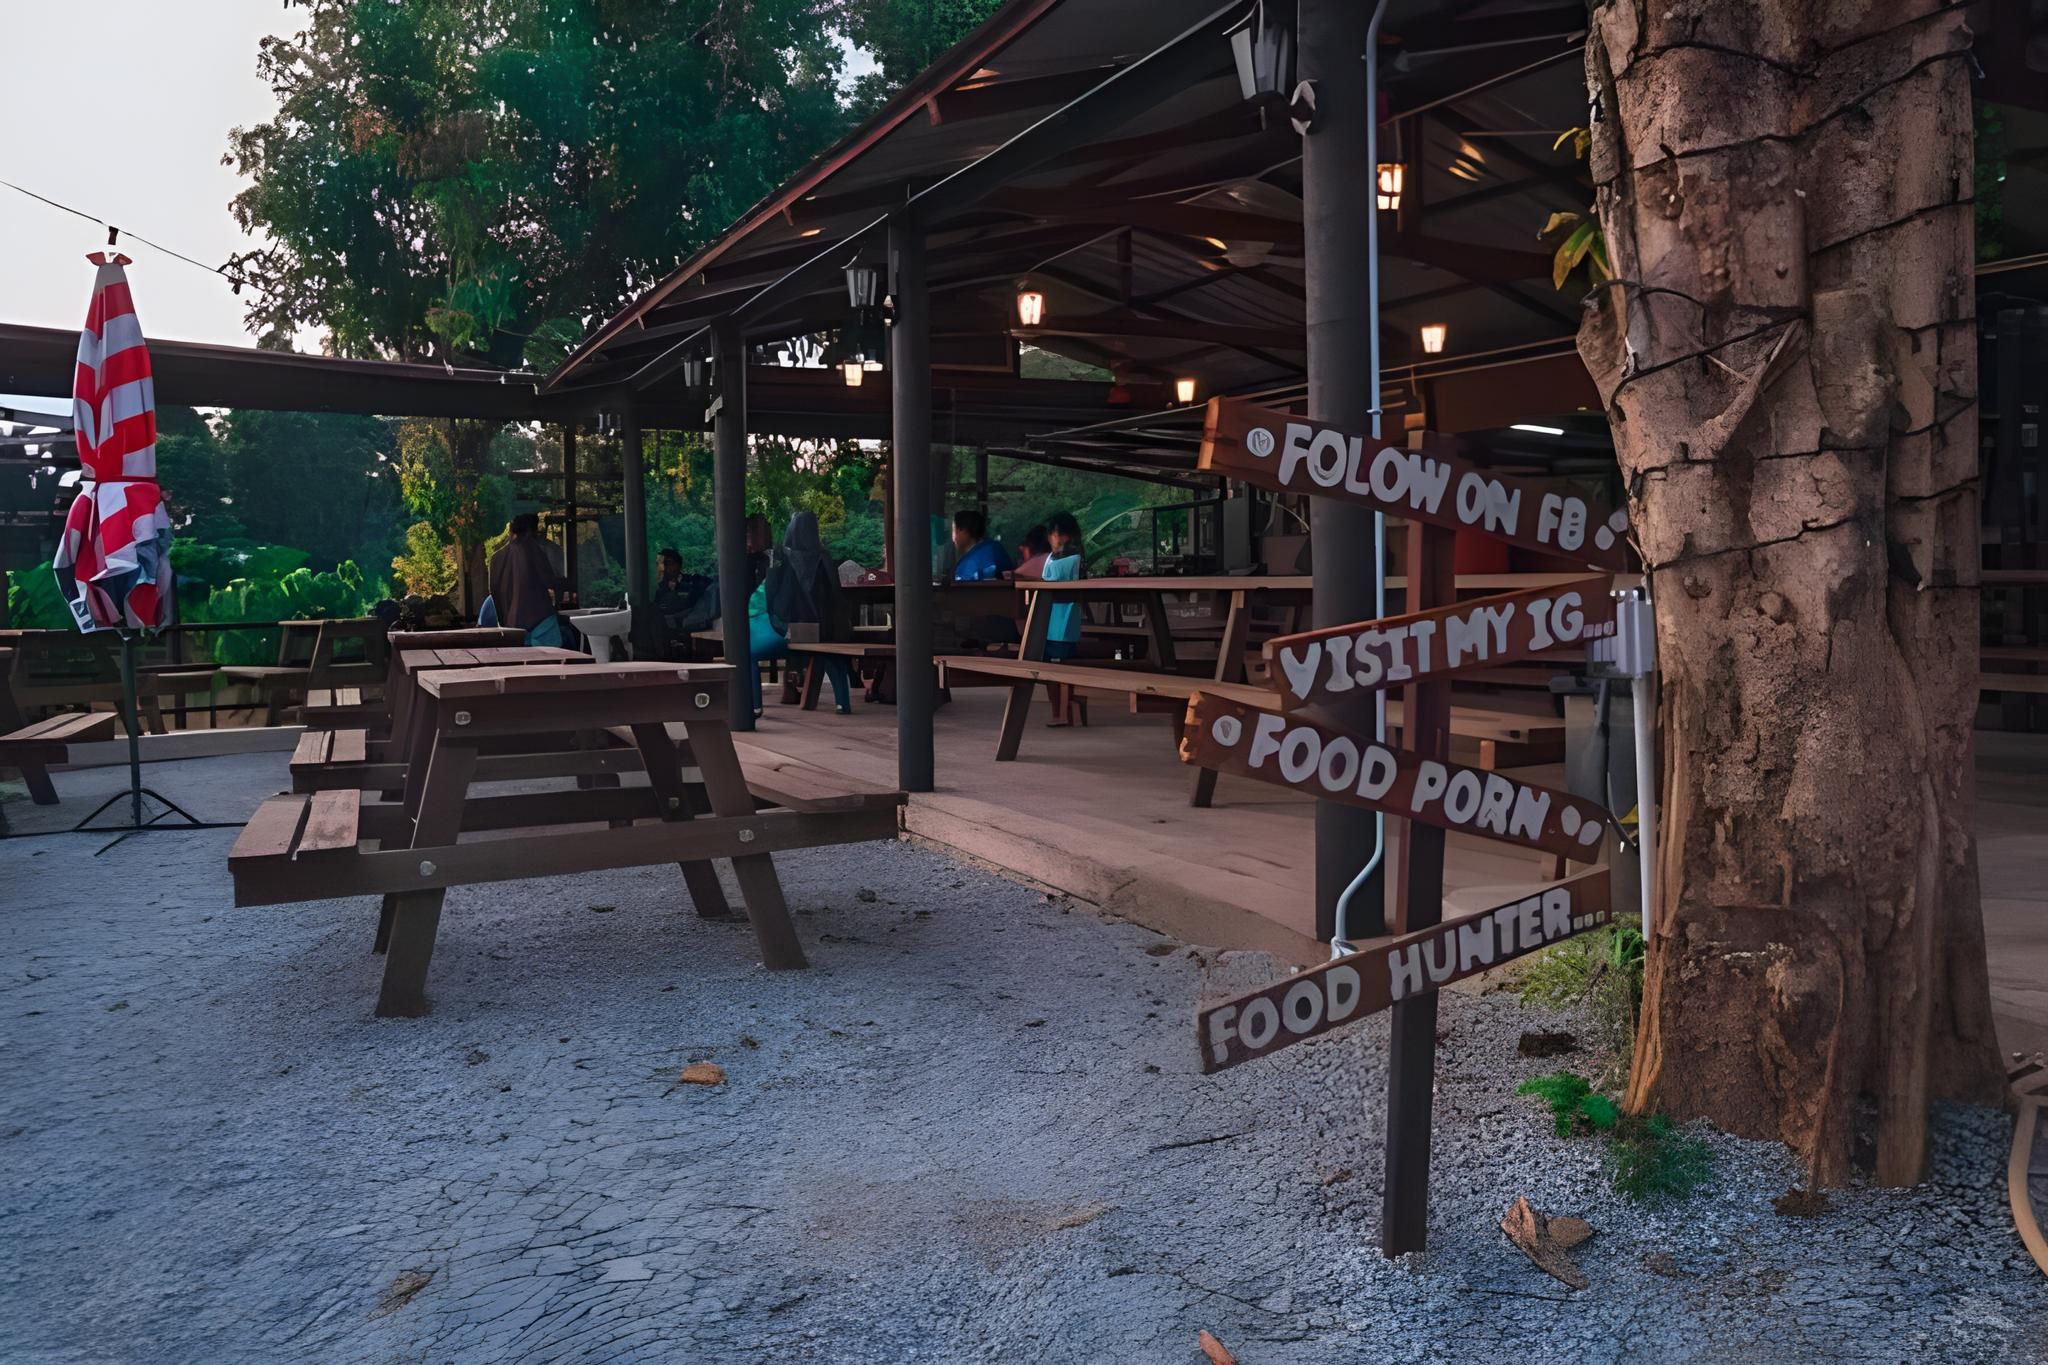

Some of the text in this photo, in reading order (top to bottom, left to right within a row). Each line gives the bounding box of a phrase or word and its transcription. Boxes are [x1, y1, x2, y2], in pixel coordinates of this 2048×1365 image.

[1278, 423, 1588, 551] FOLOW ON FB
[1280, 620, 1437, 700] VISIT
[1445, 602, 1515, 668] MY
[1249, 714, 1551, 841] FOOD PORN
[1208, 965, 1361, 1063] FOOD
